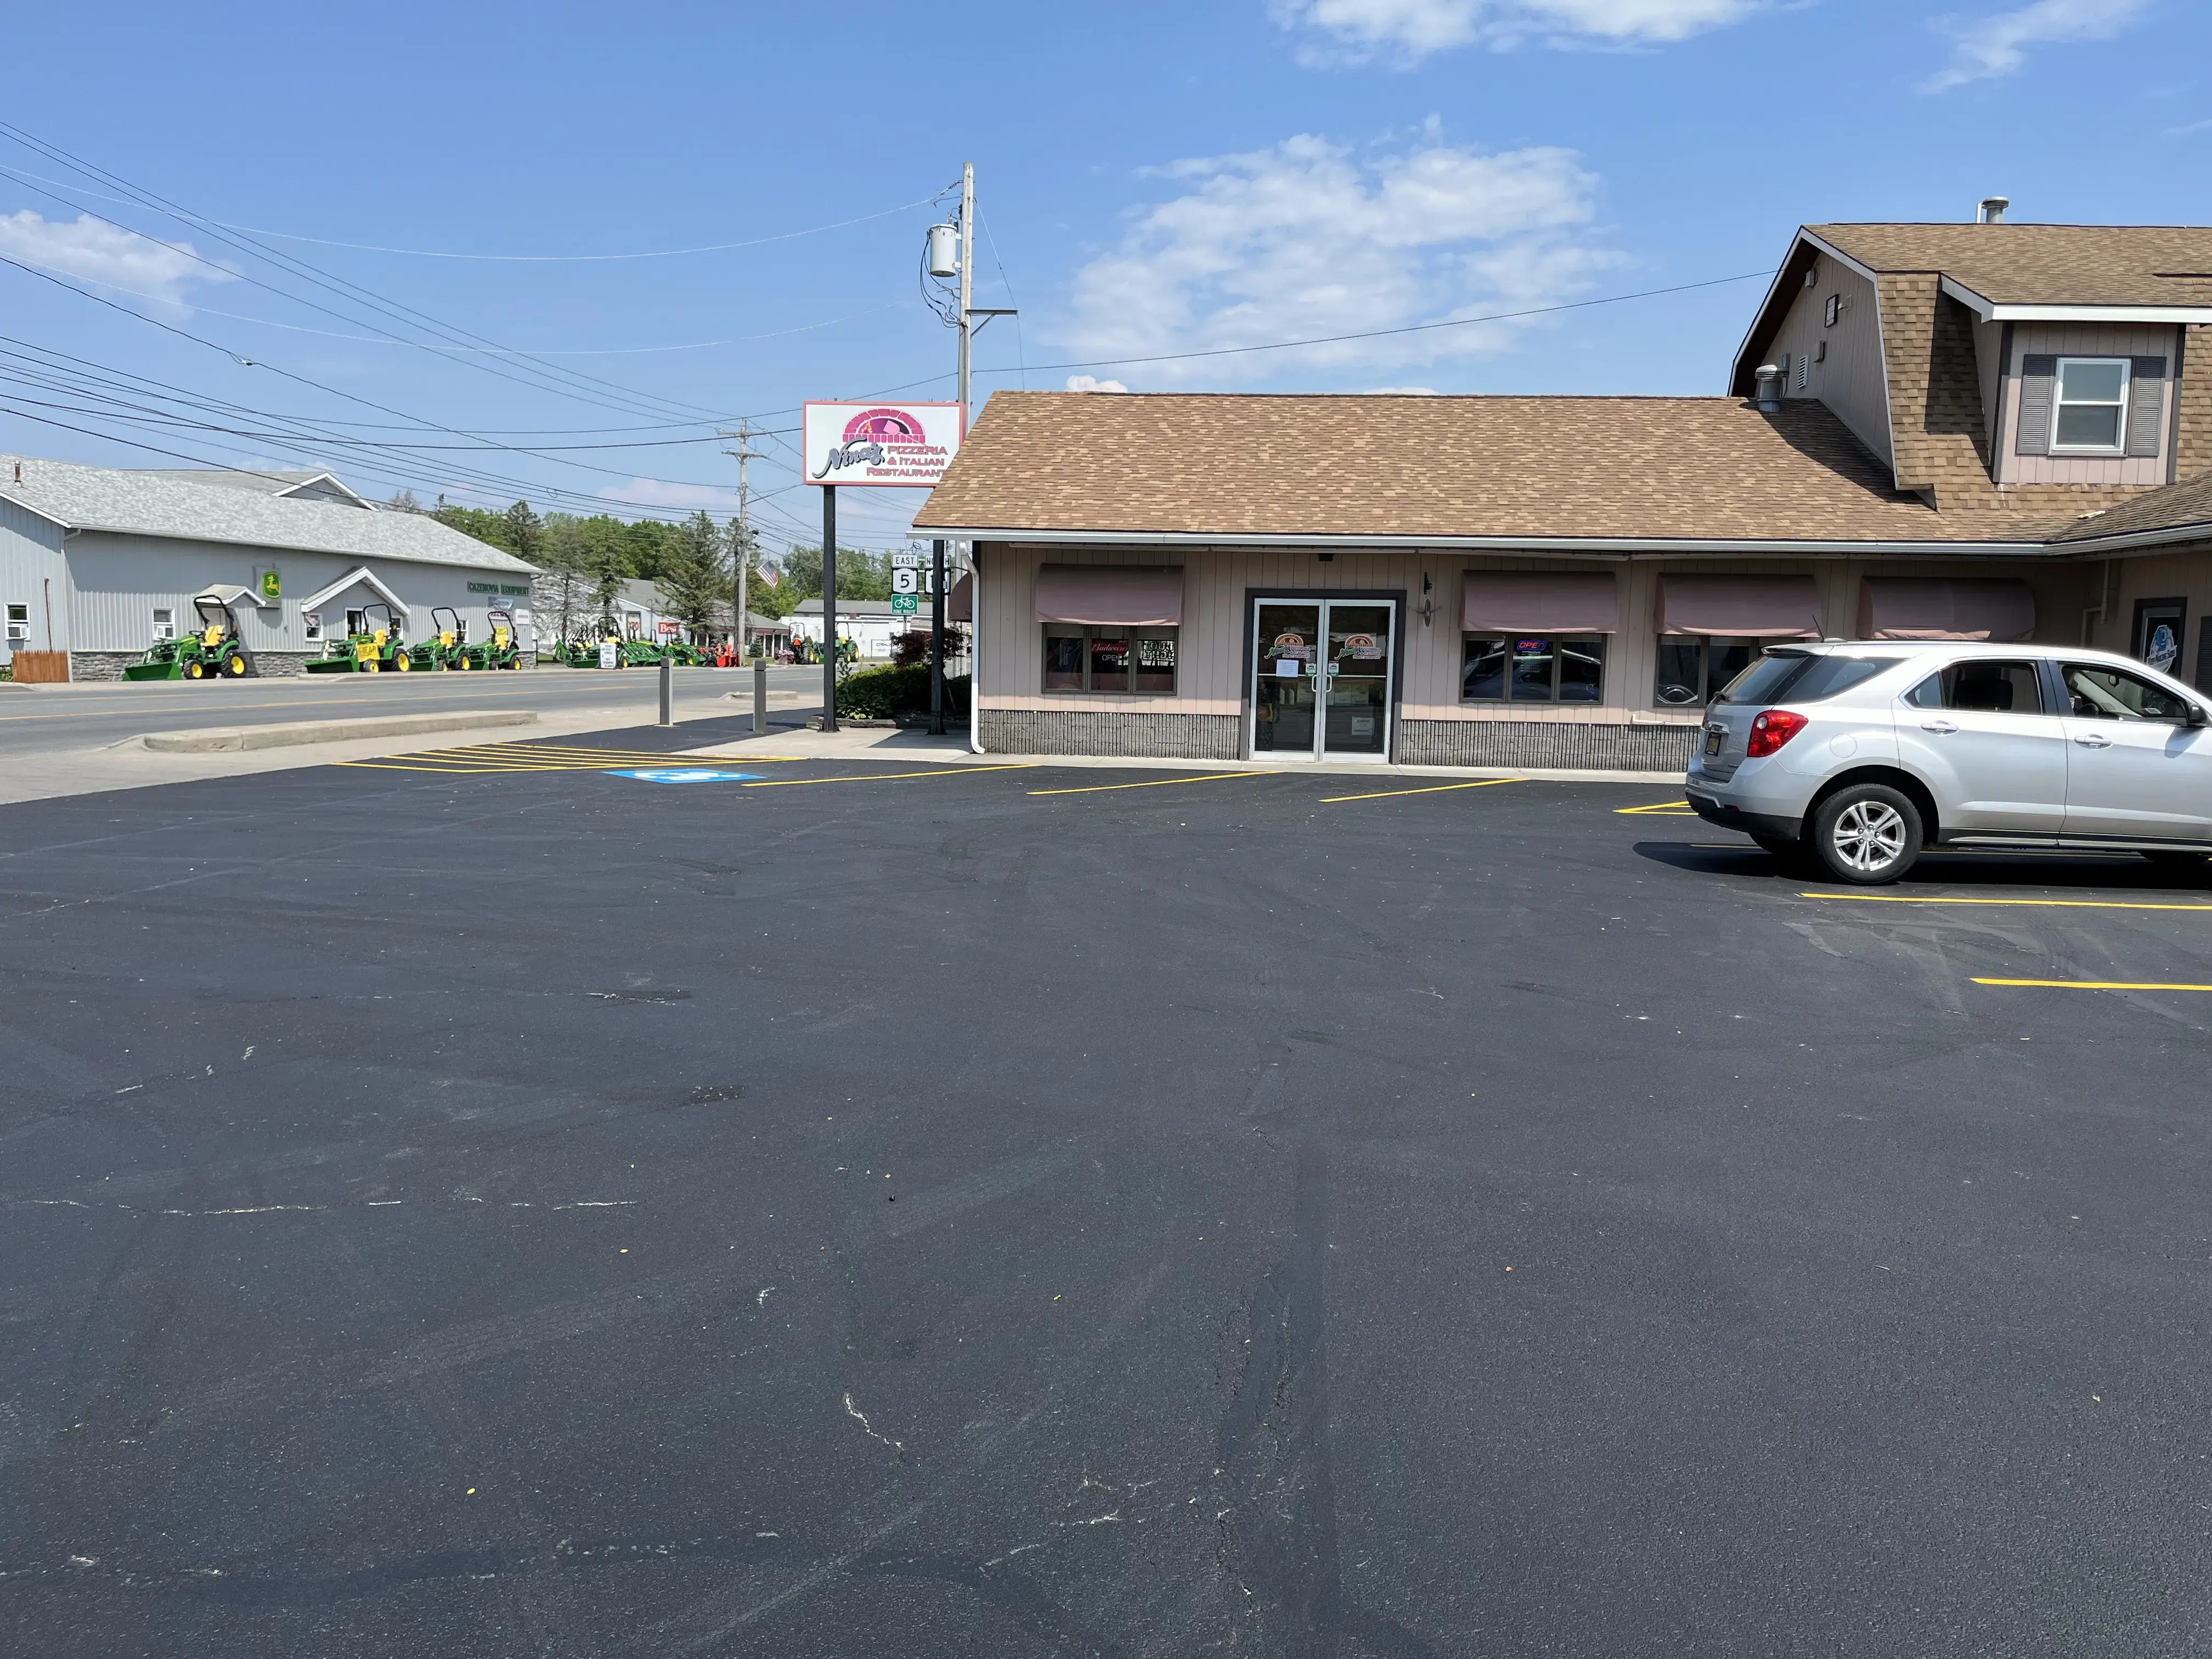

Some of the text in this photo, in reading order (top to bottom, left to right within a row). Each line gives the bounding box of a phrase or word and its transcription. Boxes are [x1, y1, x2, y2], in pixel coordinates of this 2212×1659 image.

[887, 445, 948, 455] PIZZERIA
[887, 456, 945, 466] & ITALIAN
[900, 574, 910, 588] 5
